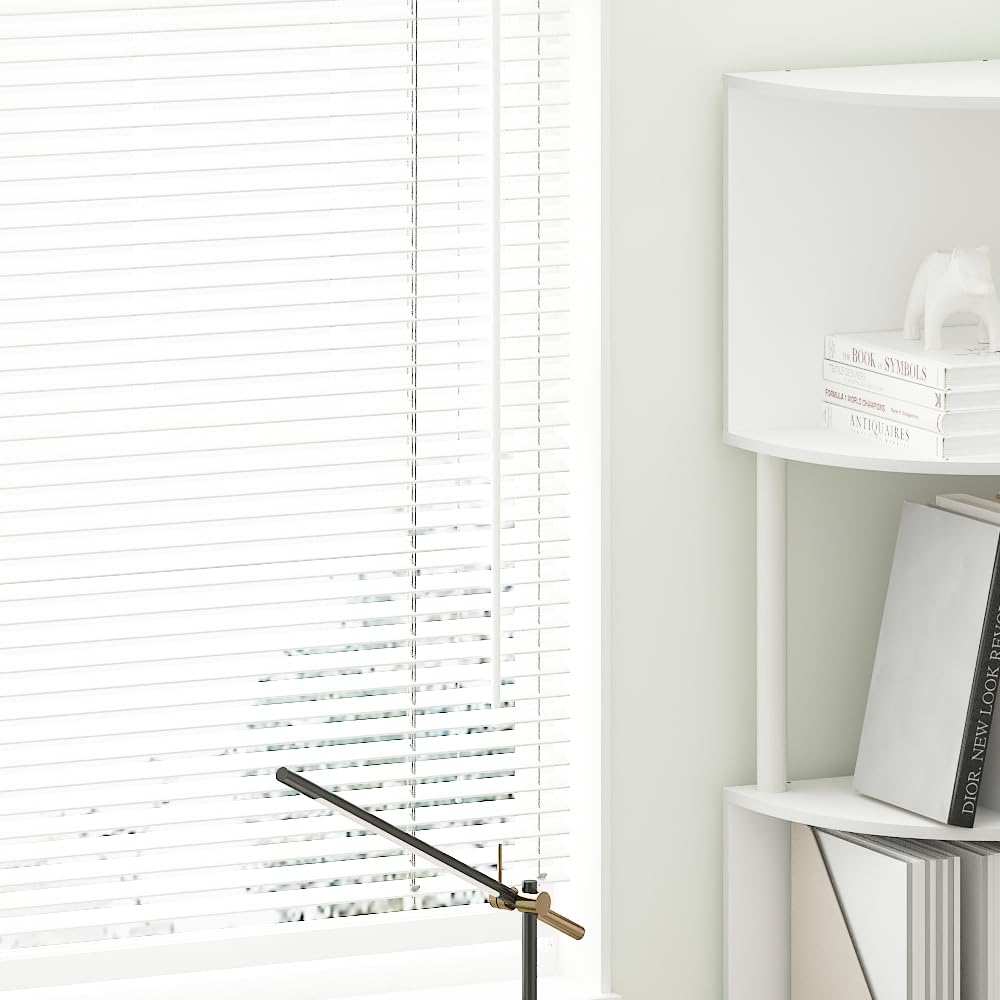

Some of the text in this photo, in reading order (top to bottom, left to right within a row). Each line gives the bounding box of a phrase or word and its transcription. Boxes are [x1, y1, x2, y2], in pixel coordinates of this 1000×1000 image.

[852, 347, 876, 368] BOOK
[884, 357, 927, 381] SYMBOLS
[850, 414, 910, 441] ANTIQUAIRES
[980, 666, 1000, 715] LOOK
[971, 720, 989, 761] NEW
[962, 767, 982, 814] DIOR.
